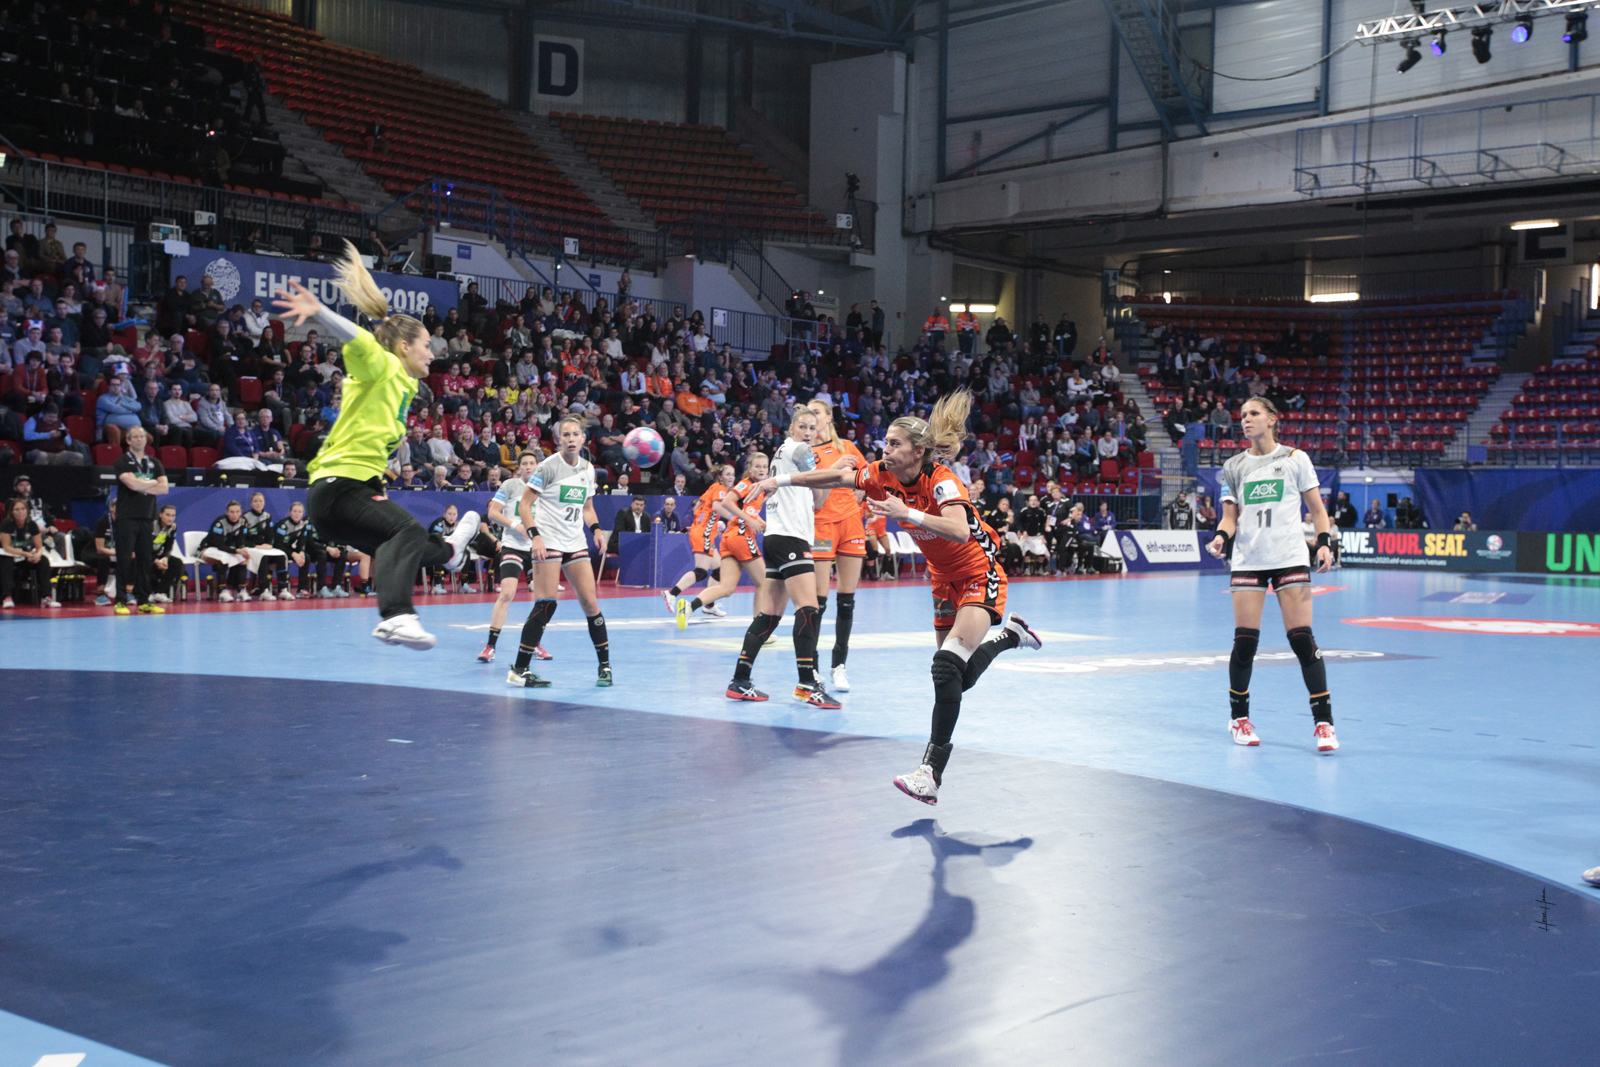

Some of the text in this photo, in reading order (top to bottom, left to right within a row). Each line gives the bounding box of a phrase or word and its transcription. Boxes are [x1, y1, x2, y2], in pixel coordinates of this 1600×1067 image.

[538, 41, 579, 96] D
[572, 240, 578, 253] 7
[381, 287, 430, 315] 2018
[565, 488, 585, 498] AOK
[1250, 483, 1278, 497] AOK
[1256, 509, 1272, 528] 11
[1146, 541, 1194, 553] ehf-euro.com
[1376, 532, 1423, 555] YOUR.
[1424, 533, 1468, 556] SEAT.
[1546, 533, 1600, 572] UN
